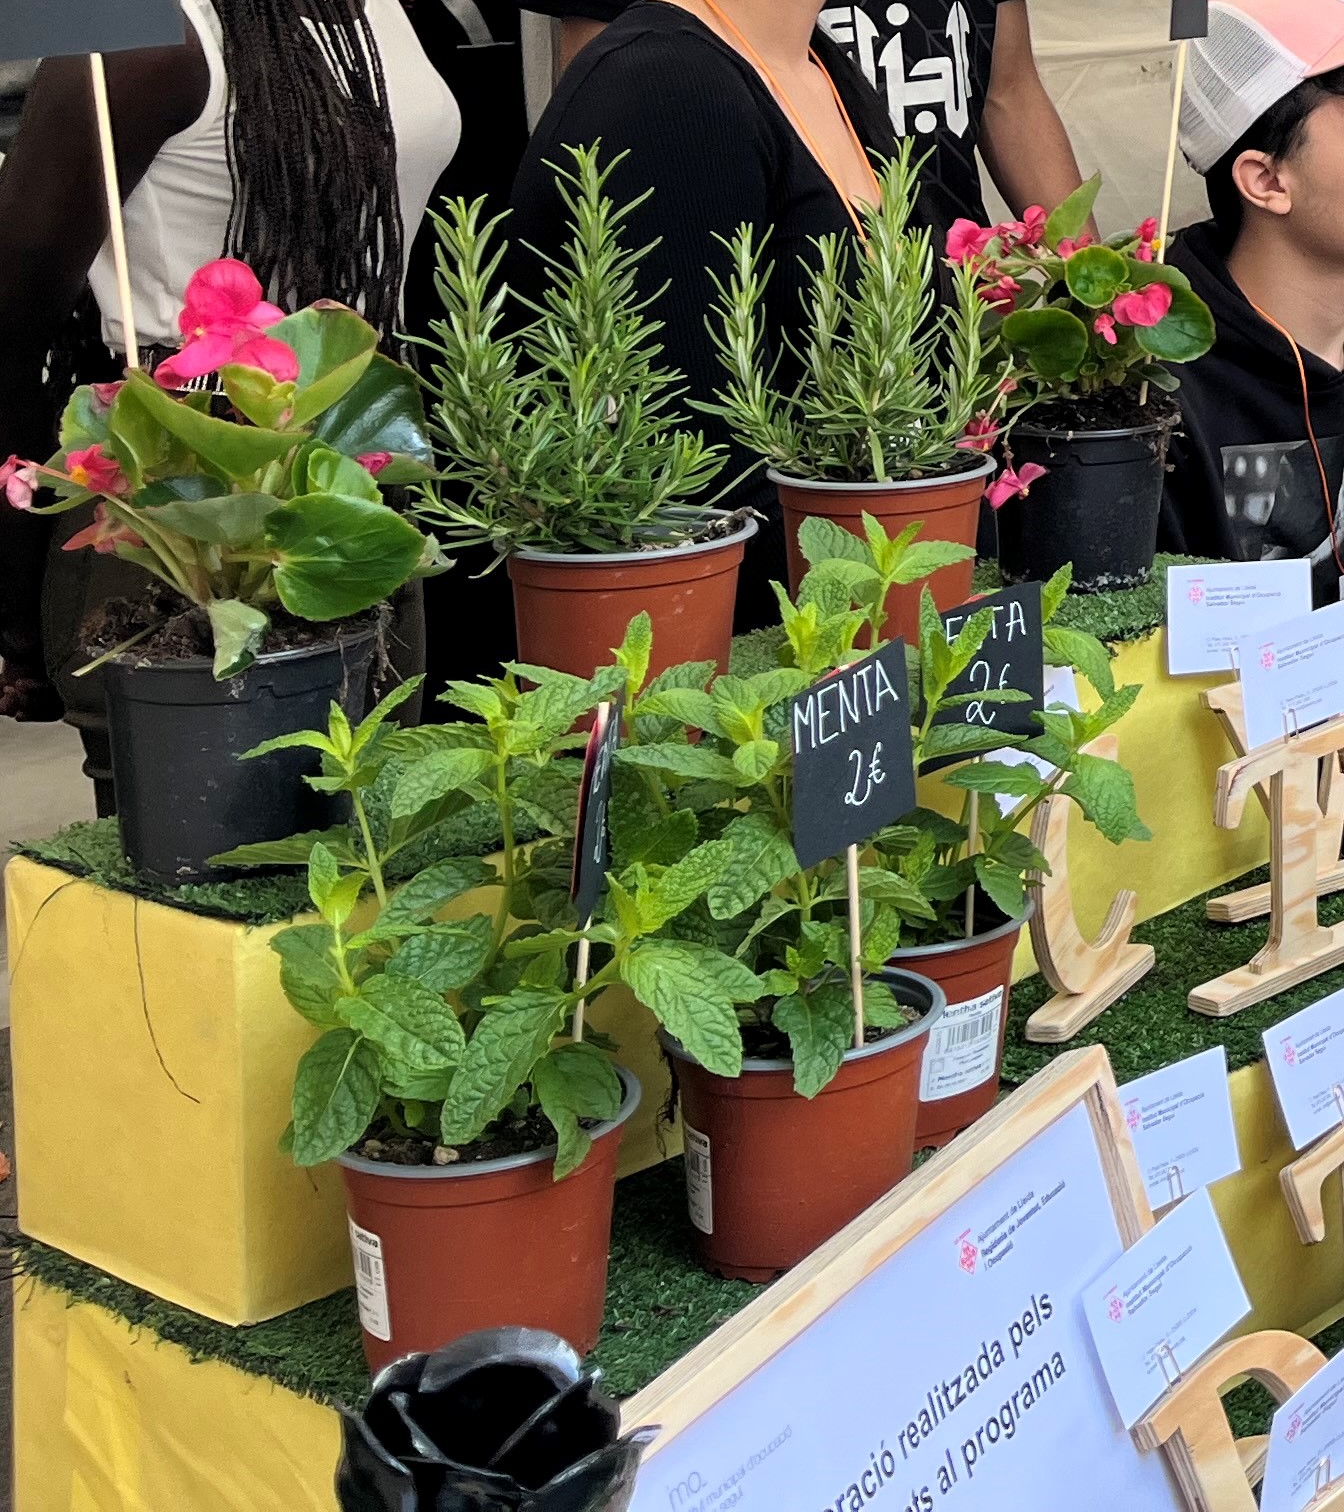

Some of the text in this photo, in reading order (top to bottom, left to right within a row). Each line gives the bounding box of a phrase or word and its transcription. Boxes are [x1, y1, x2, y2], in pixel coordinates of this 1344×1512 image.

[792, 658, 899, 755] MENTA
[897, 1338, 1005, 1460] realitzada
[1008, 1291, 1053, 1359] pels
[937, 1448, 958, 1496] al
[961, 1351, 1067, 1478] programa
